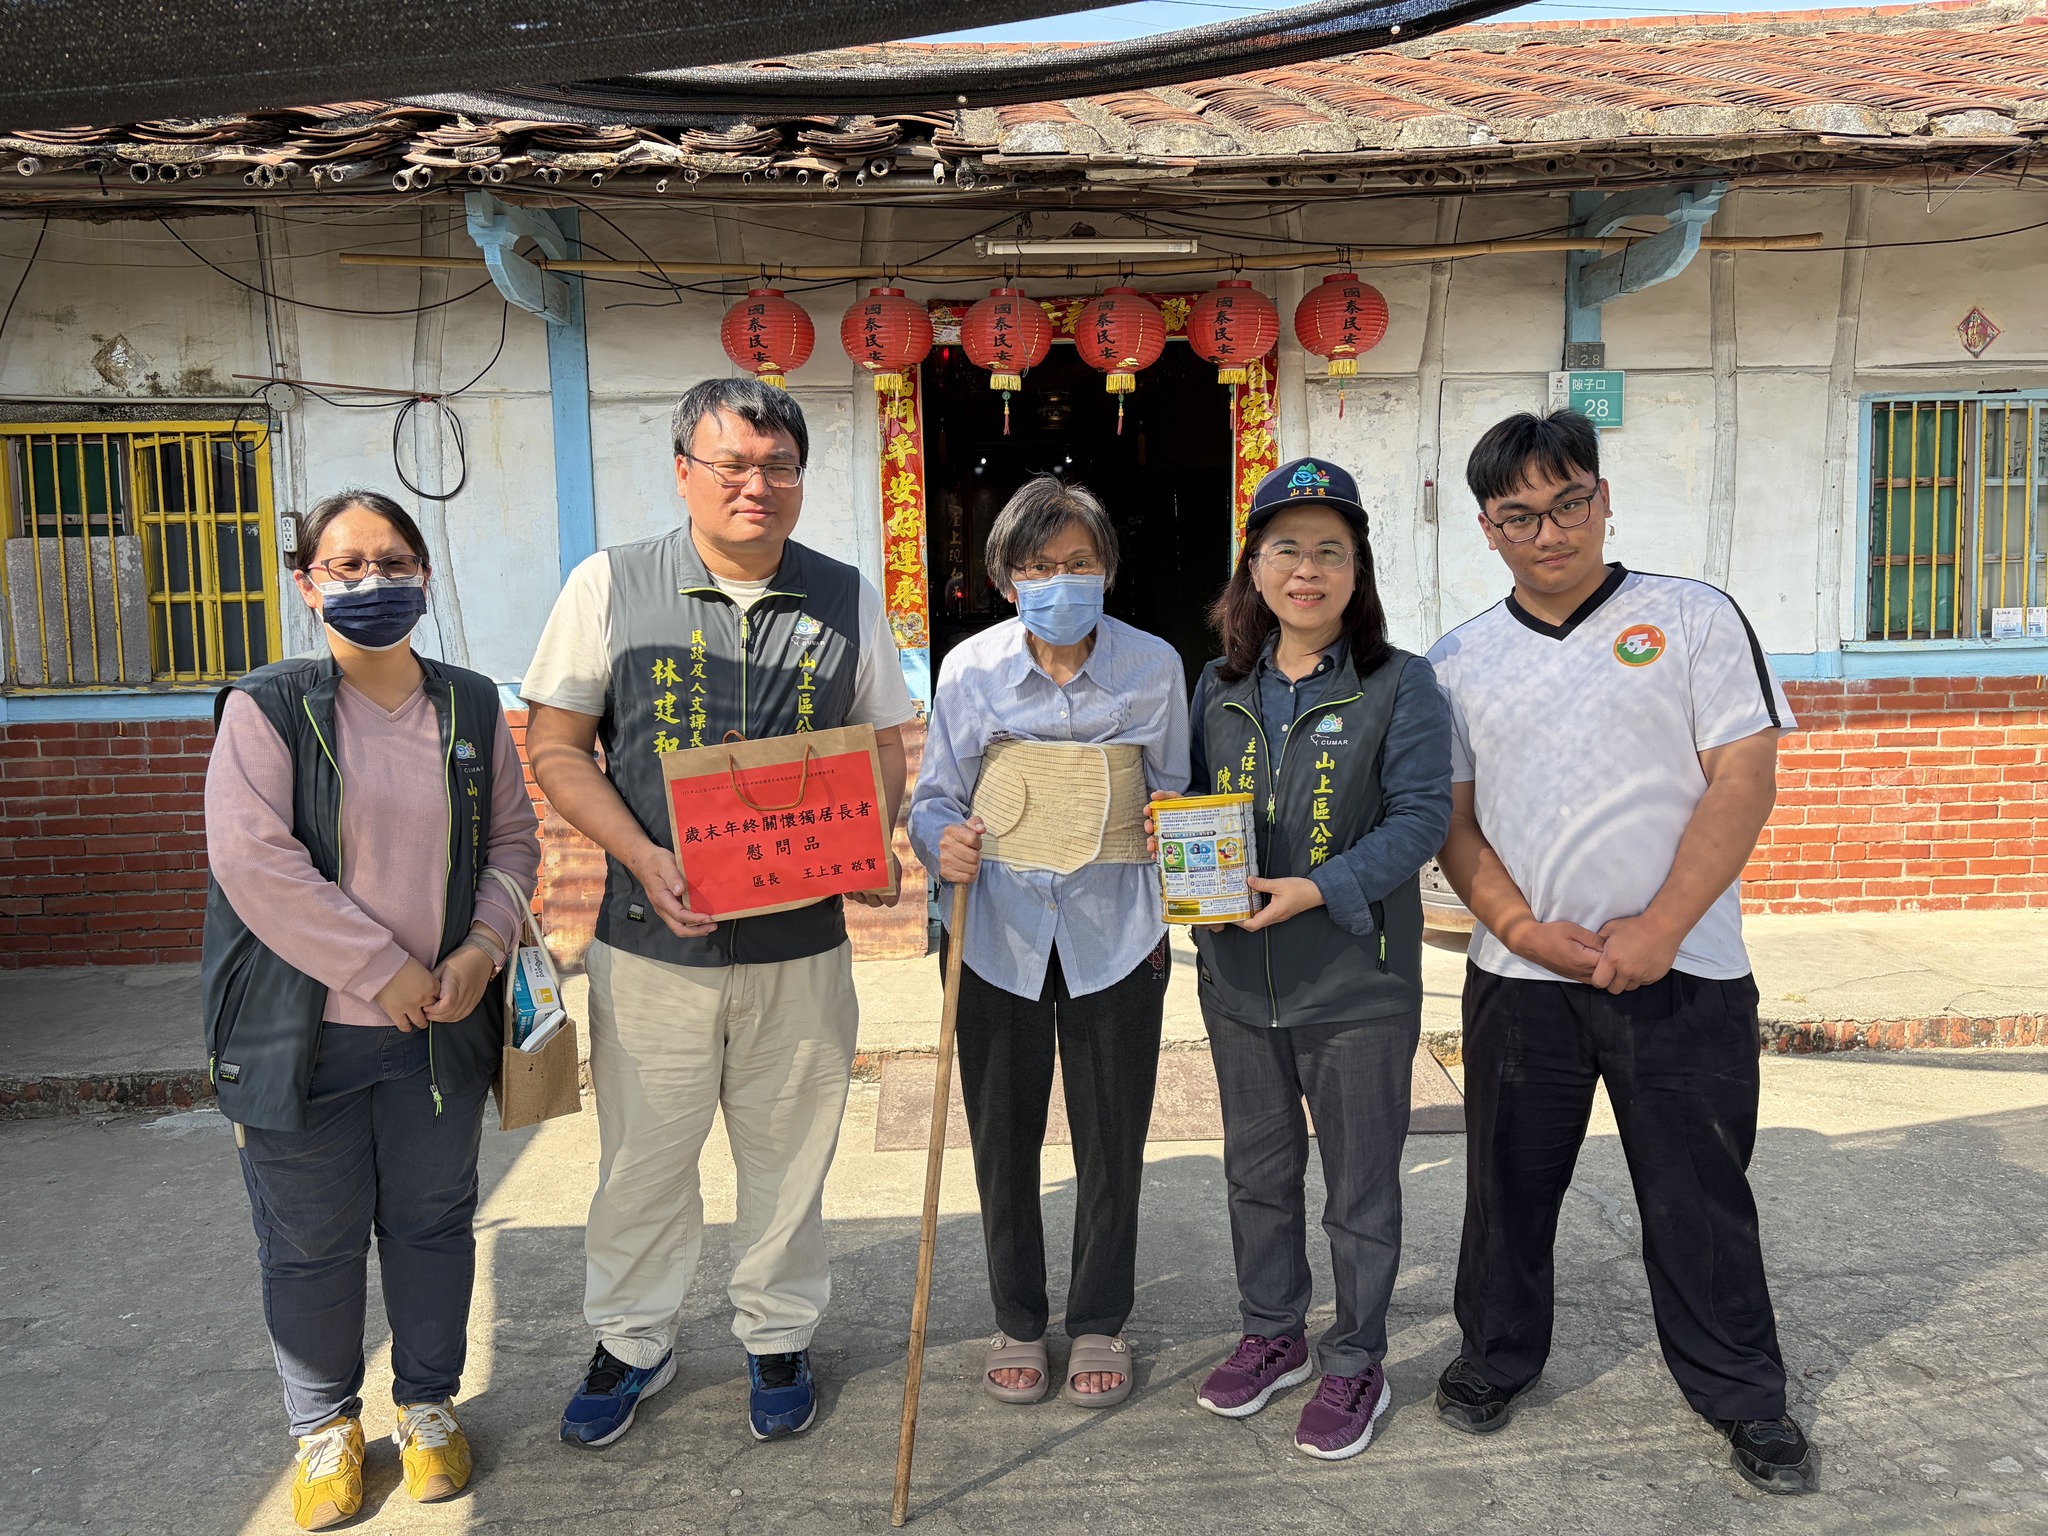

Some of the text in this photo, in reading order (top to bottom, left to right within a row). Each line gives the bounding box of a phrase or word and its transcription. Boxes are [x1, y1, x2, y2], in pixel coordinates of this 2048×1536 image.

[747, 303, 773, 363] 國泰民安
[864, 303, 887, 362] 國泰民安
[993, 303, 1014, 361] 國泰民安
[1095, 301, 1119, 359] 國泰民安
[1212, 296, 1236, 354] 國泰民安
[1339, 287, 1364, 345] 國泰民安
[1584, 398, 1609, 417] 28
[651, 657, 684, 759] 林建和
[689, 629, 707, 747] 民政及人文課長
[1217, 765, 1233, 795] 陳
[1238, 736, 1257, 794] 主任秘
[684, 800, 873, 845] 歲末年終關懷獨居長者
[1309, 751, 1336, 866] 山上區公所
[746, 835, 821, 861] 慰問品
[752, 872, 781, 888] 區長
